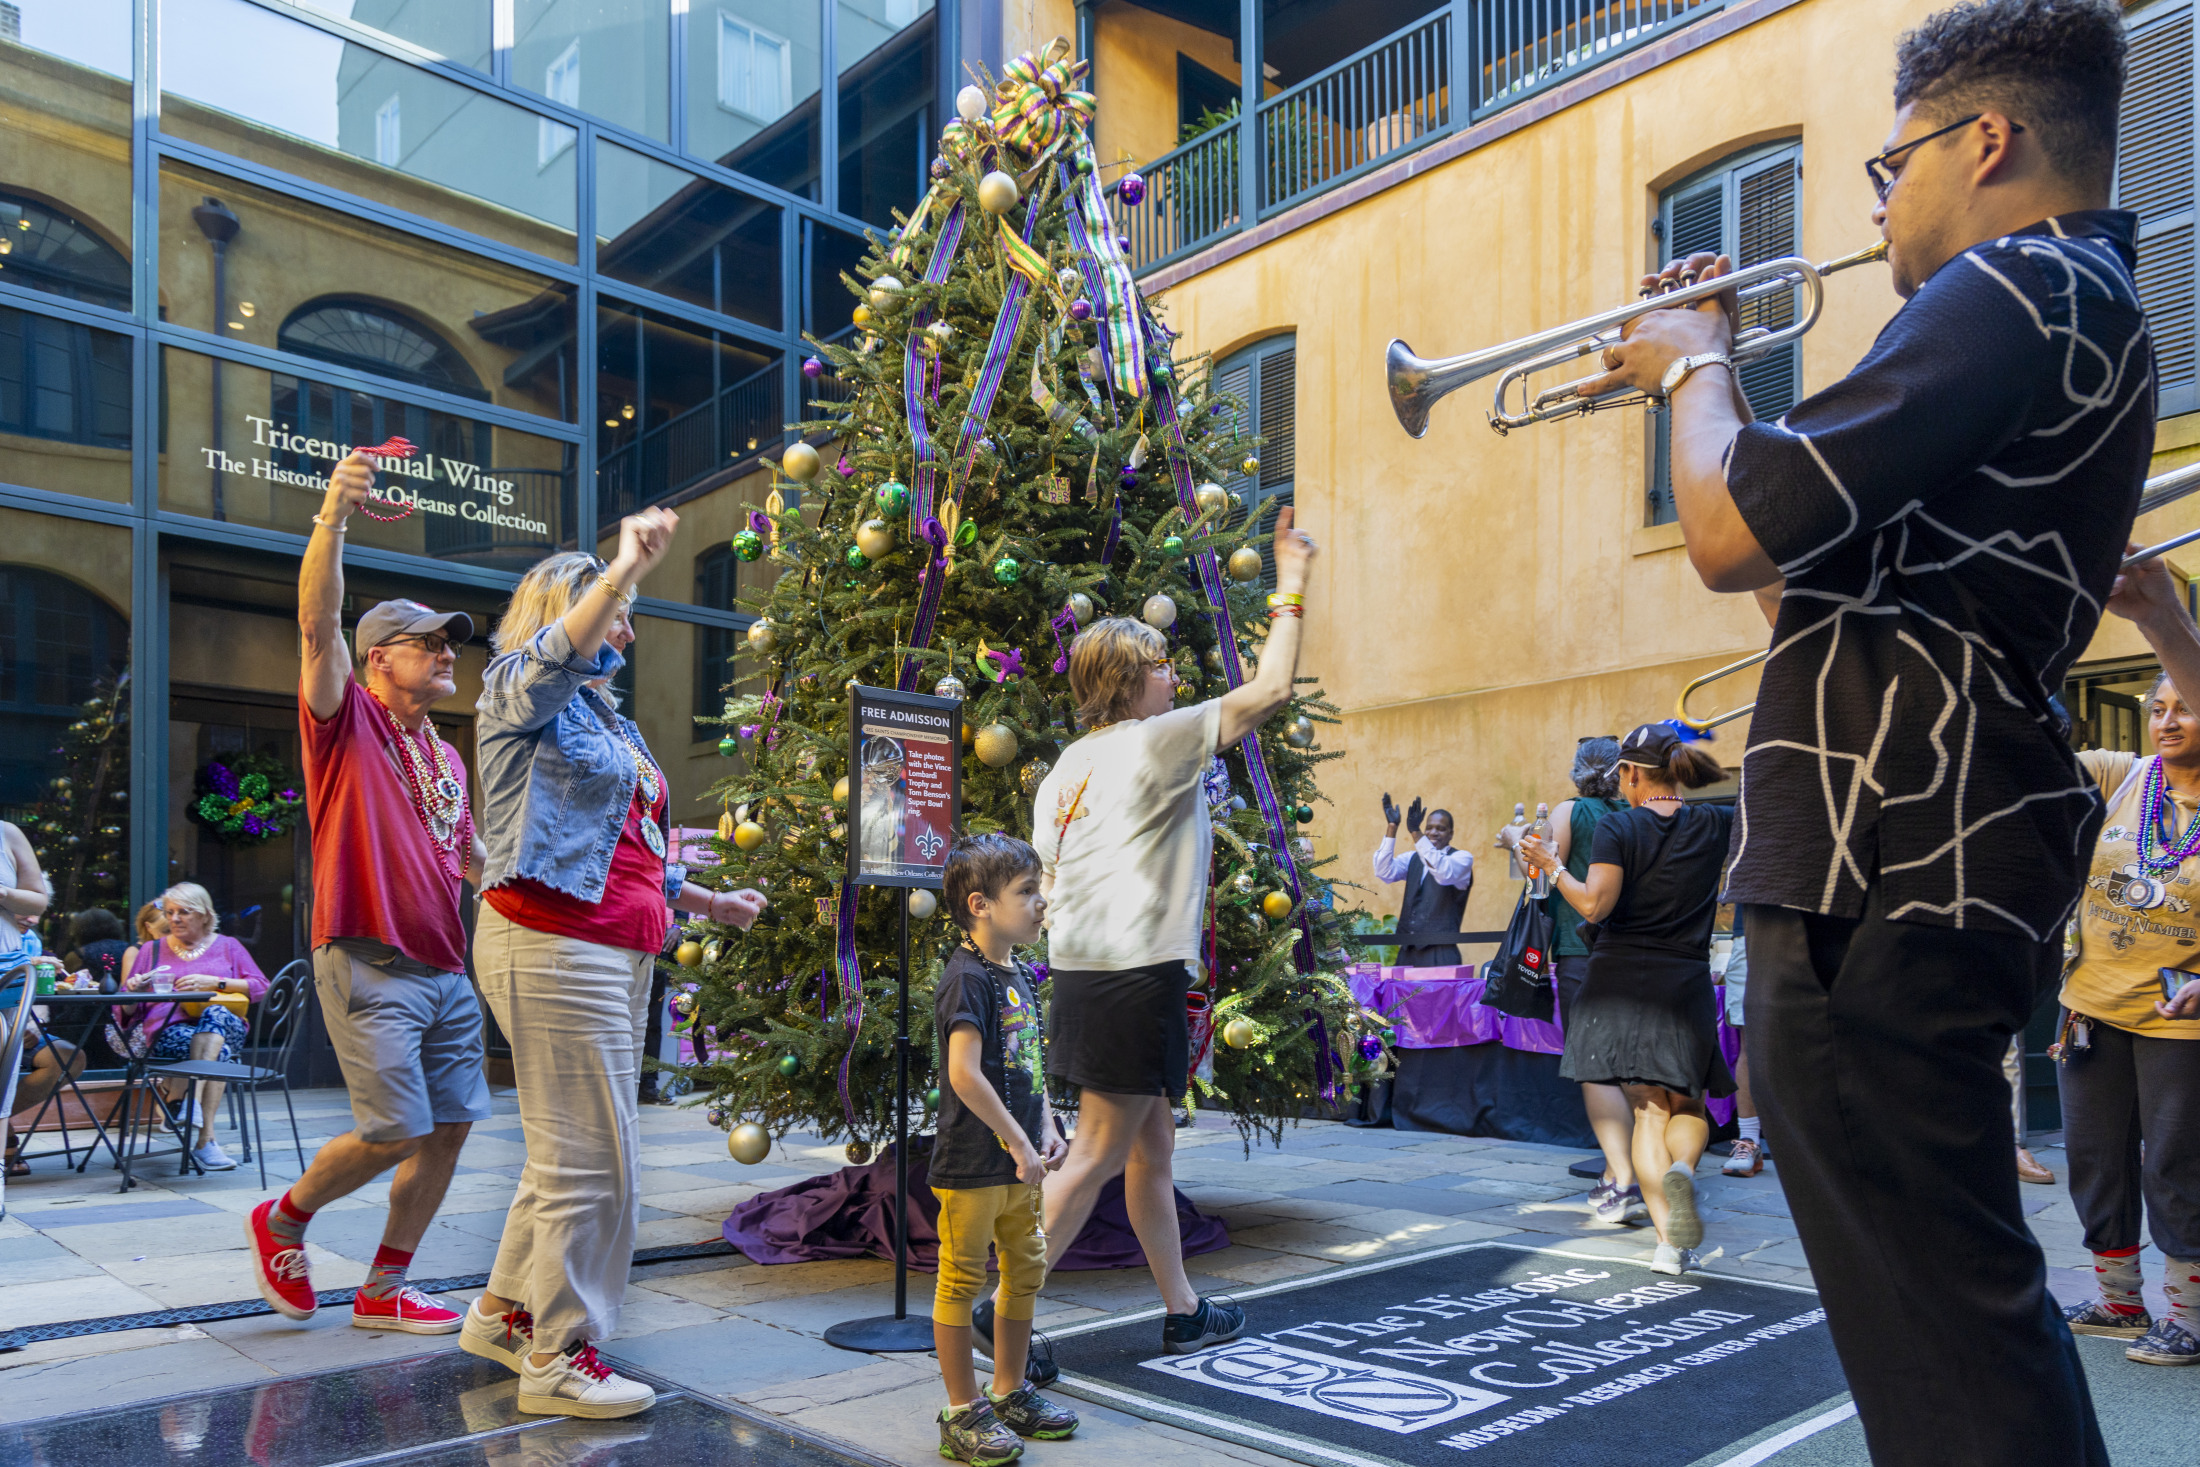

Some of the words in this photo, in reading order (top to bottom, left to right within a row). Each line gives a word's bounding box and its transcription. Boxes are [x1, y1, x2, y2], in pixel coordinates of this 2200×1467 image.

[245, 414, 434, 481] Tricentnial
[440, 457, 514, 505] Wing
[201, 447, 246, 475] The
[387, 486, 456, 516] Orleans
[461, 501, 548, 535] Collection
[861, 706, 887, 719] FREE
[889, 711, 950, 728] ADMISSION
[890, 730, 923, 738] CHAMPIONSHIP
[908, 750, 923, 759] Take
[923, 752, 945, 762] photos
[908, 760, 922, 768] with
[923, 761, 934, 770] the
[934, 763, 952, 772] Vince
[908, 769, 938, 779] Lombardi
[908, 779, 930, 789] Trophy
[908, 788, 922, 796] Tom
[923, 790, 951, 799] Benson's
[908, 798, 926, 807] Super
[927, 800, 943, 808] Bowl
[908, 807, 922, 817] ring.
[904, 869, 924, 877] Orleans
[2130, 916, 2198, 939] NUMBER
[1517, 964, 1539, 979] TOYOTA
[1261, 1314, 1426, 1347] The
[1386, 1267, 1611, 1319] Historic
[1359, 1324, 1536, 1368] New
[1502, 1280, 1702, 1328] Orleans
[1469, 1309, 1755, 1388] Collection
[1436, 1405, 1568, 1450] MUSEUM
[1563, 1363, 1687, 1406] RESEARCH
[1673, 1339, 1757, 1366] CENTER
